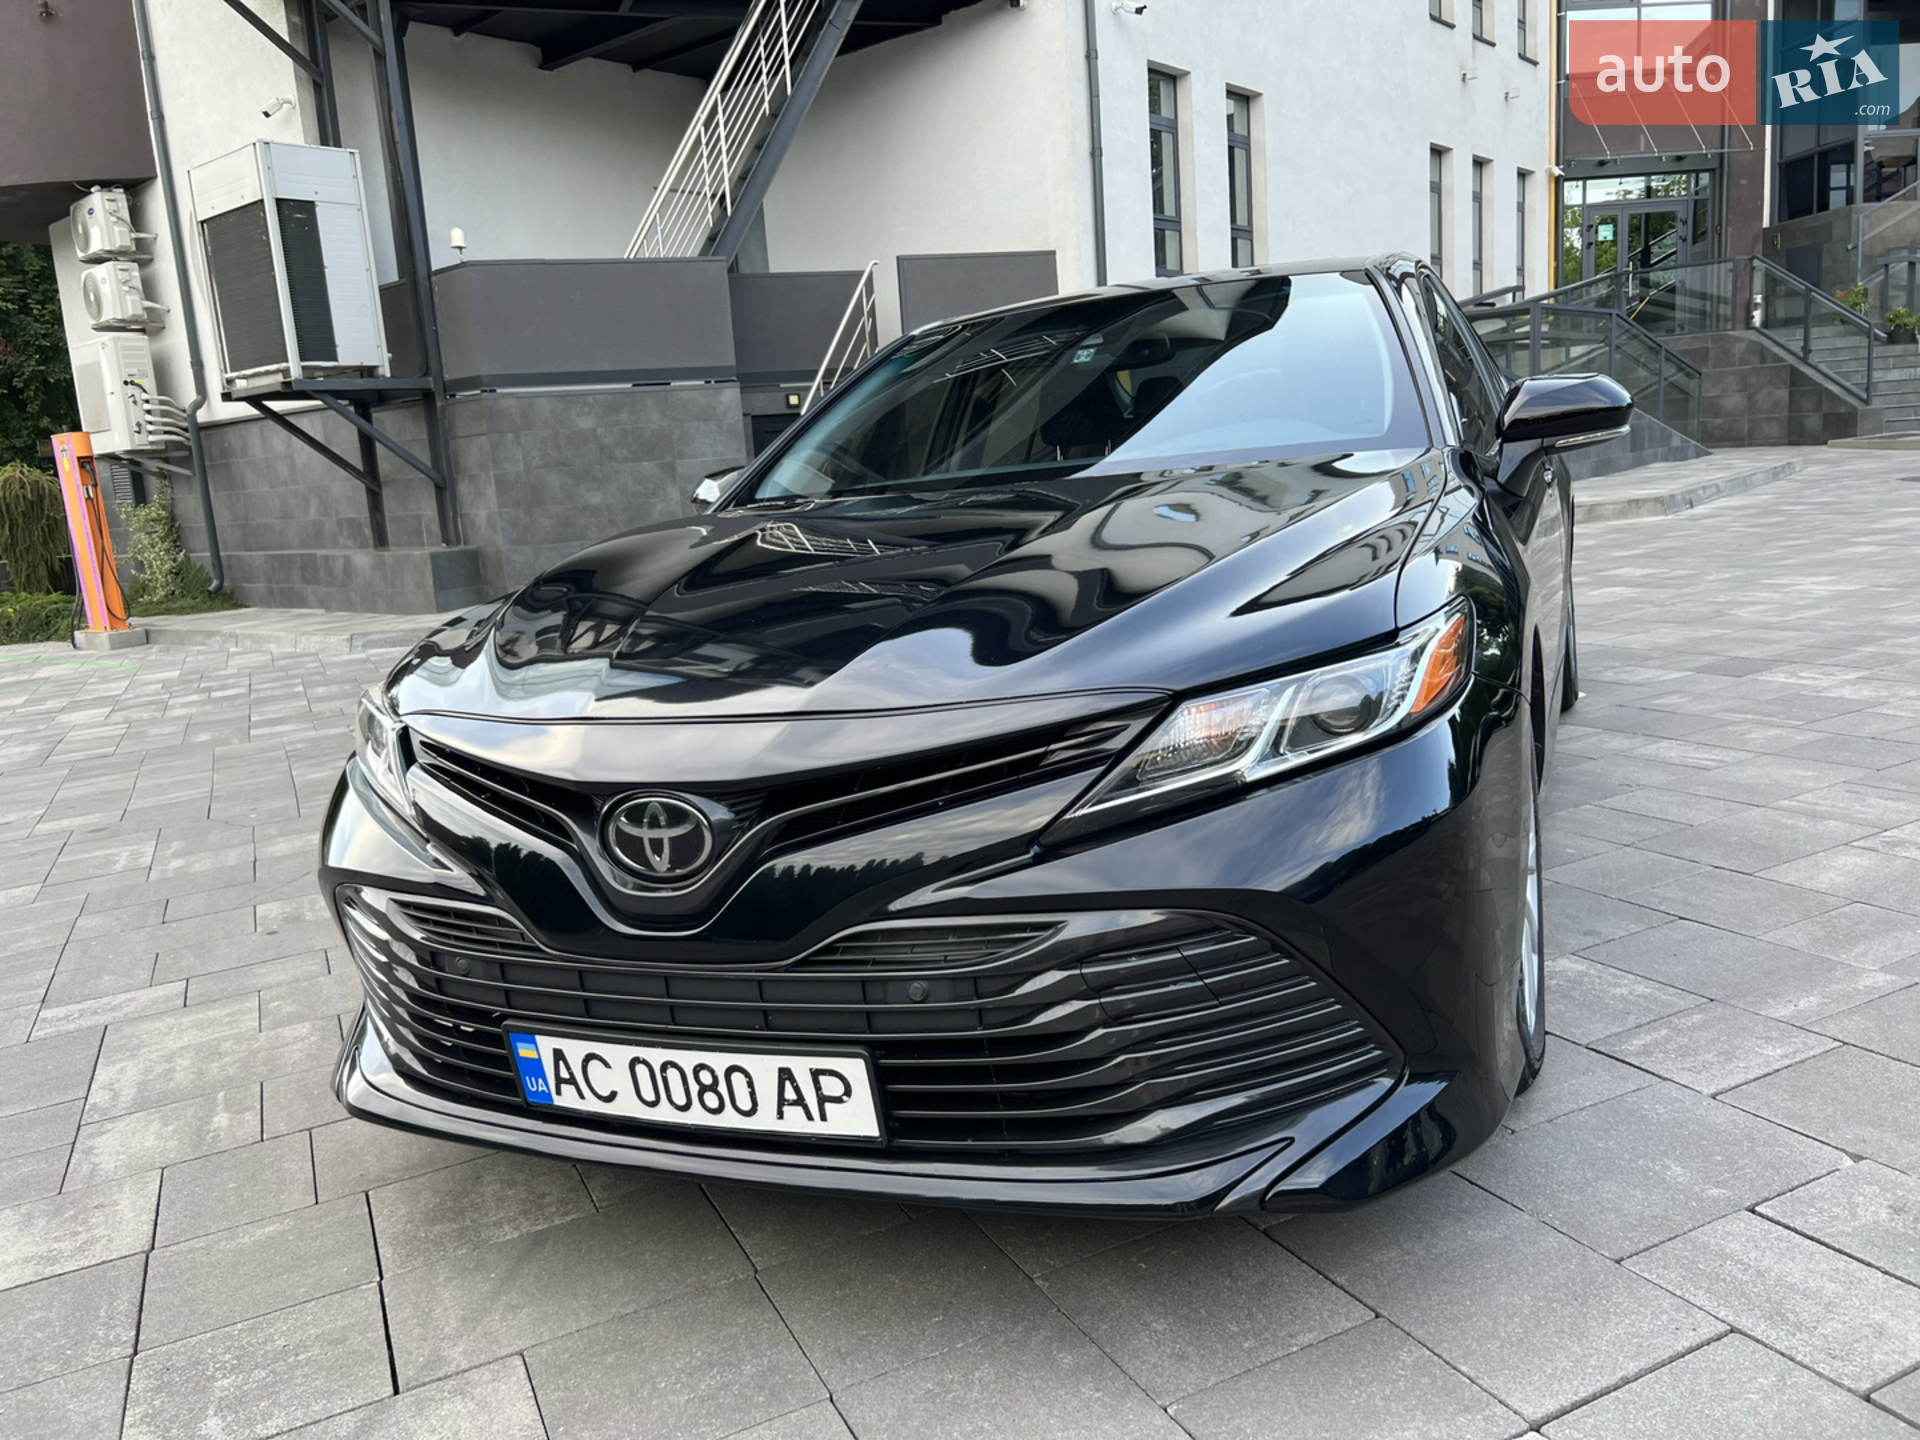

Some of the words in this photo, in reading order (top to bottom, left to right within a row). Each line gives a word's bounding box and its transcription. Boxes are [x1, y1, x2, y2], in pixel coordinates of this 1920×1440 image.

[526, 1075, 548, 1093] UA
[551, 1048, 618, 1104] AC
[628, 1056, 759, 1117] 0080
[776, 1066, 853, 1122] AP
